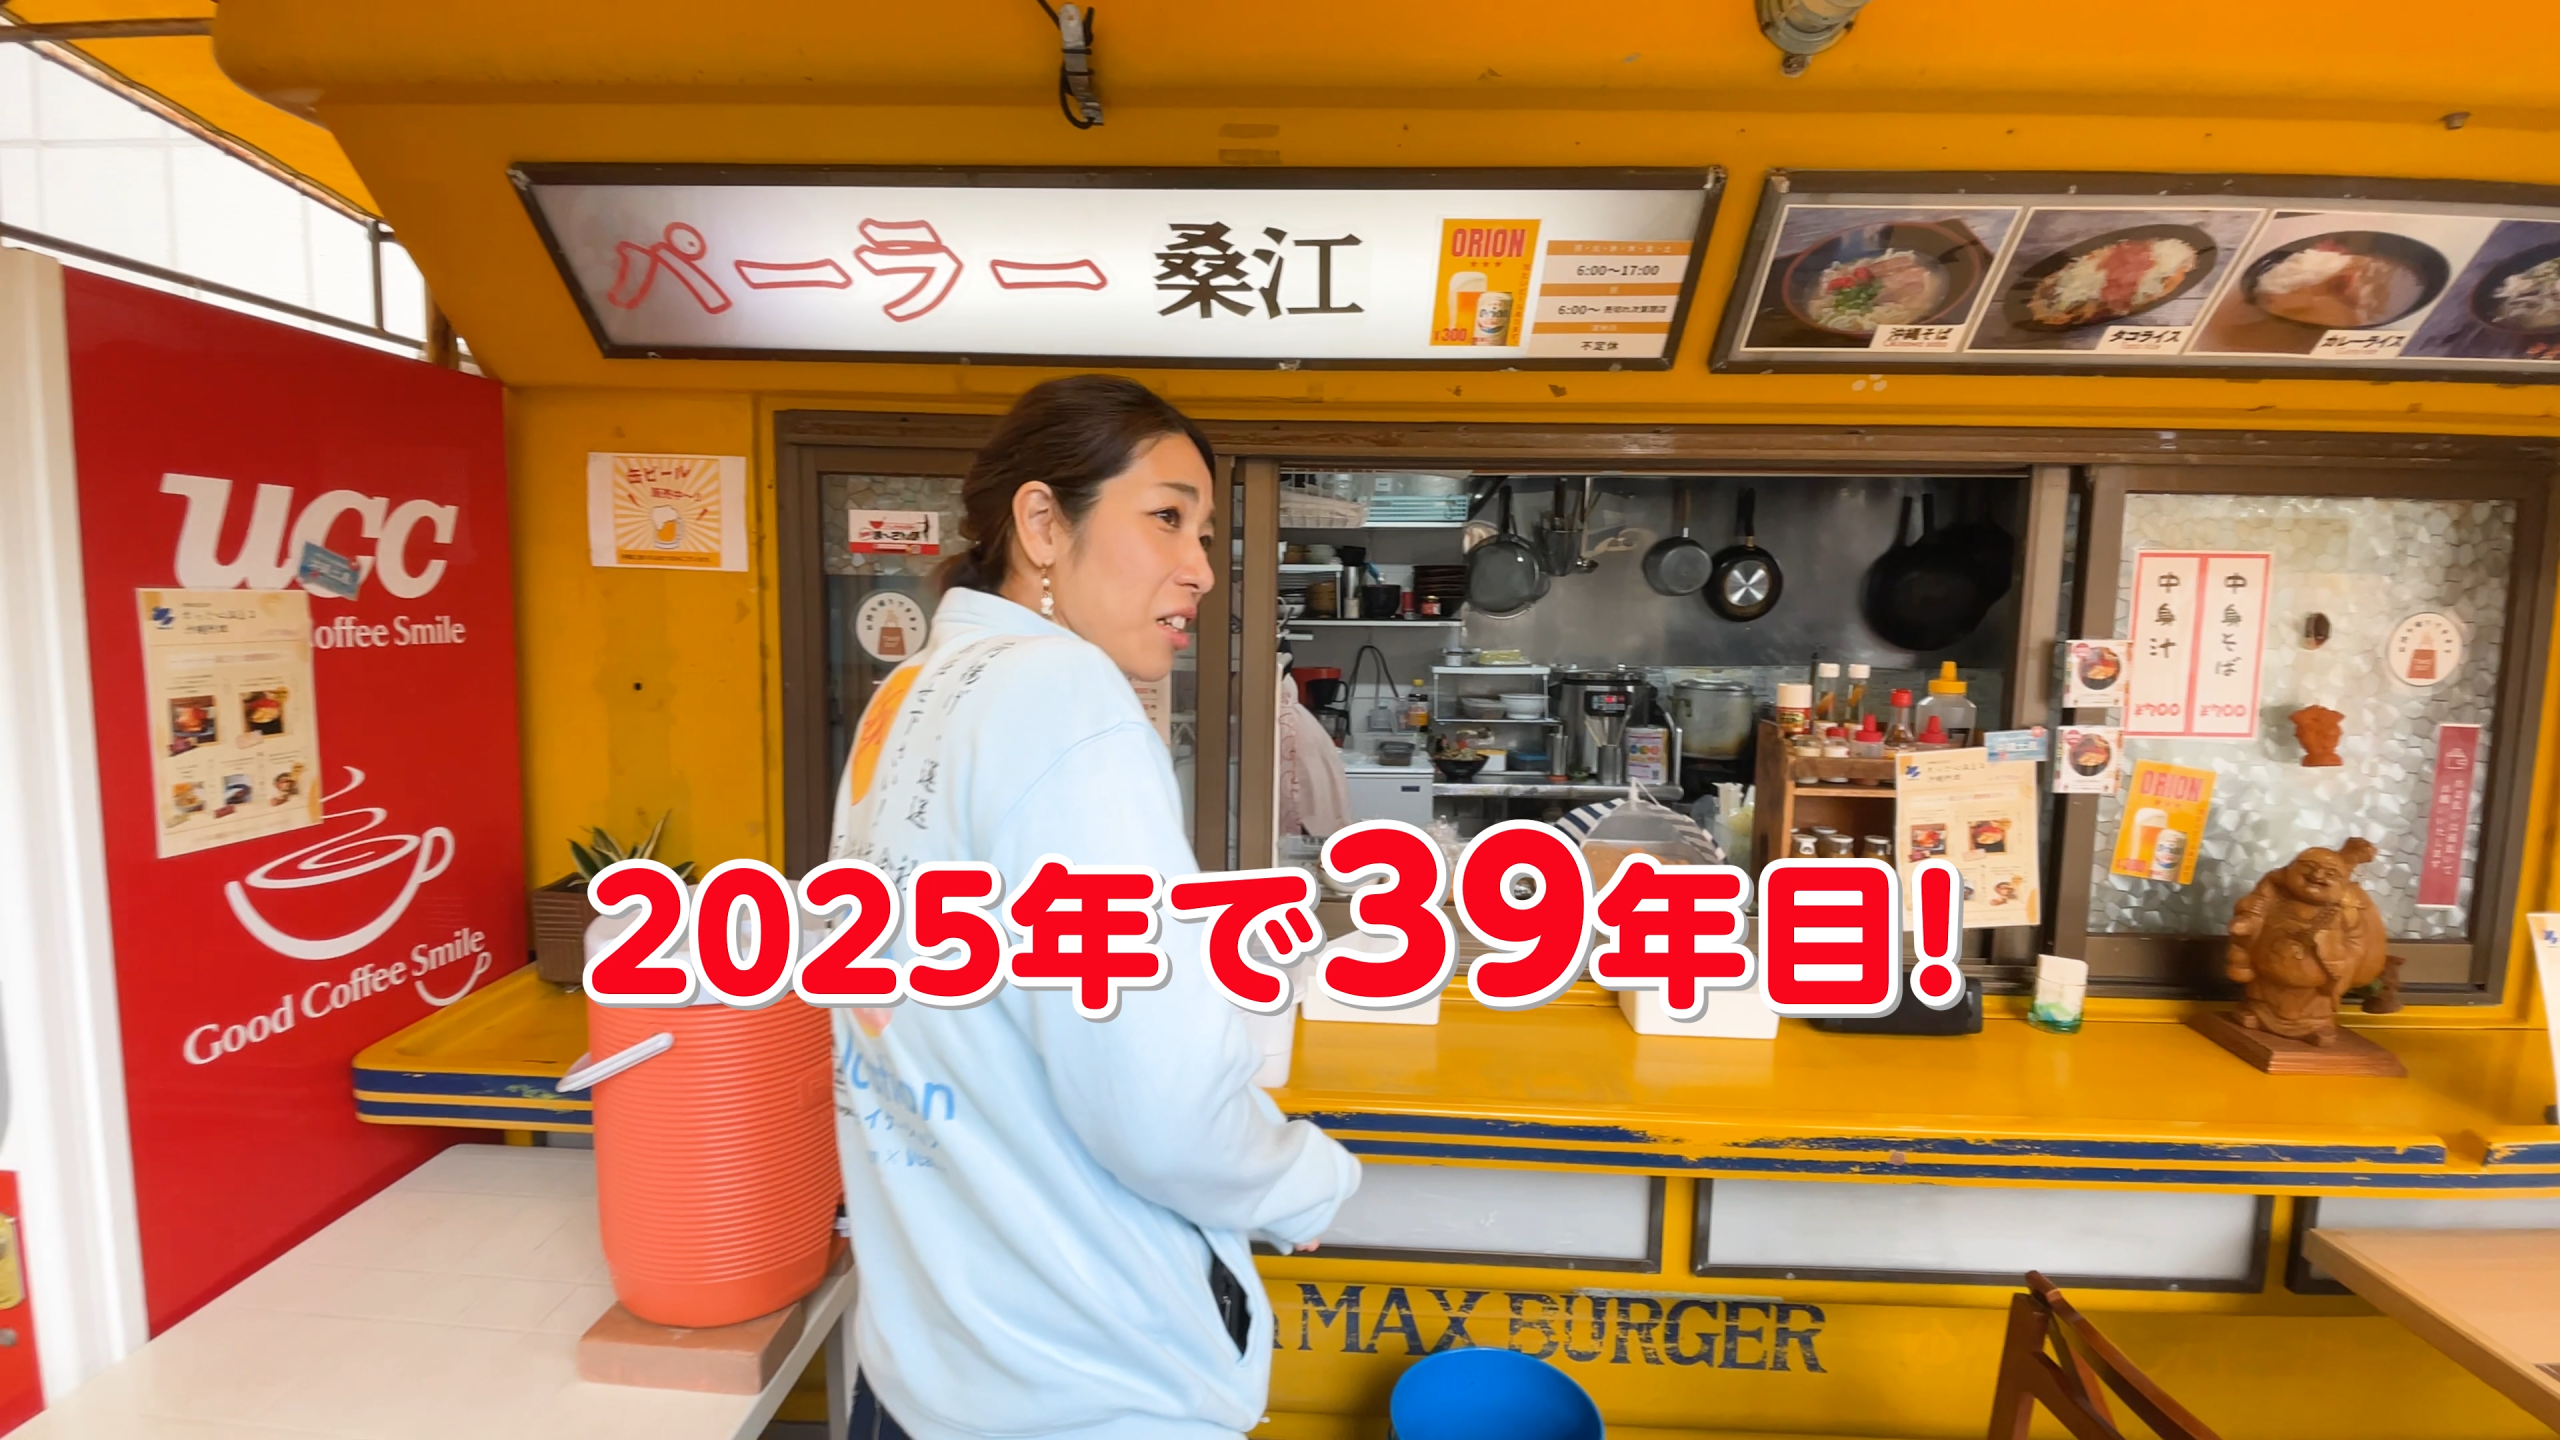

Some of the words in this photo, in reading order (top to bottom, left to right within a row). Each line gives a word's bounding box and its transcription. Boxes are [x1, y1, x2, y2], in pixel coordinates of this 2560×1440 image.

[607, 221, 1108, 322] パーラー
[1153, 221, 1365, 320] 桑江
[1451, 227, 1526, 258] ORION
[1580, 341, 1620, 351] 不定休
[2107, 330, 2182, 343] タコライス
[309, 615, 390, 650] offee
[393, 615, 467, 647] Smile
[2149, 571, 2181, 659] 中身汁
[2213, 572, 2248, 677] 中身そば
[2140, 769, 2205, 804] ORION
[182, 994, 295, 1066] Good
[301, 961, 408, 1019] Coffee
[410, 927, 486, 978] Smile
[1297, 1283, 1490, 1356] MAX
[1508, 1291, 1829, 1374] BURGER
